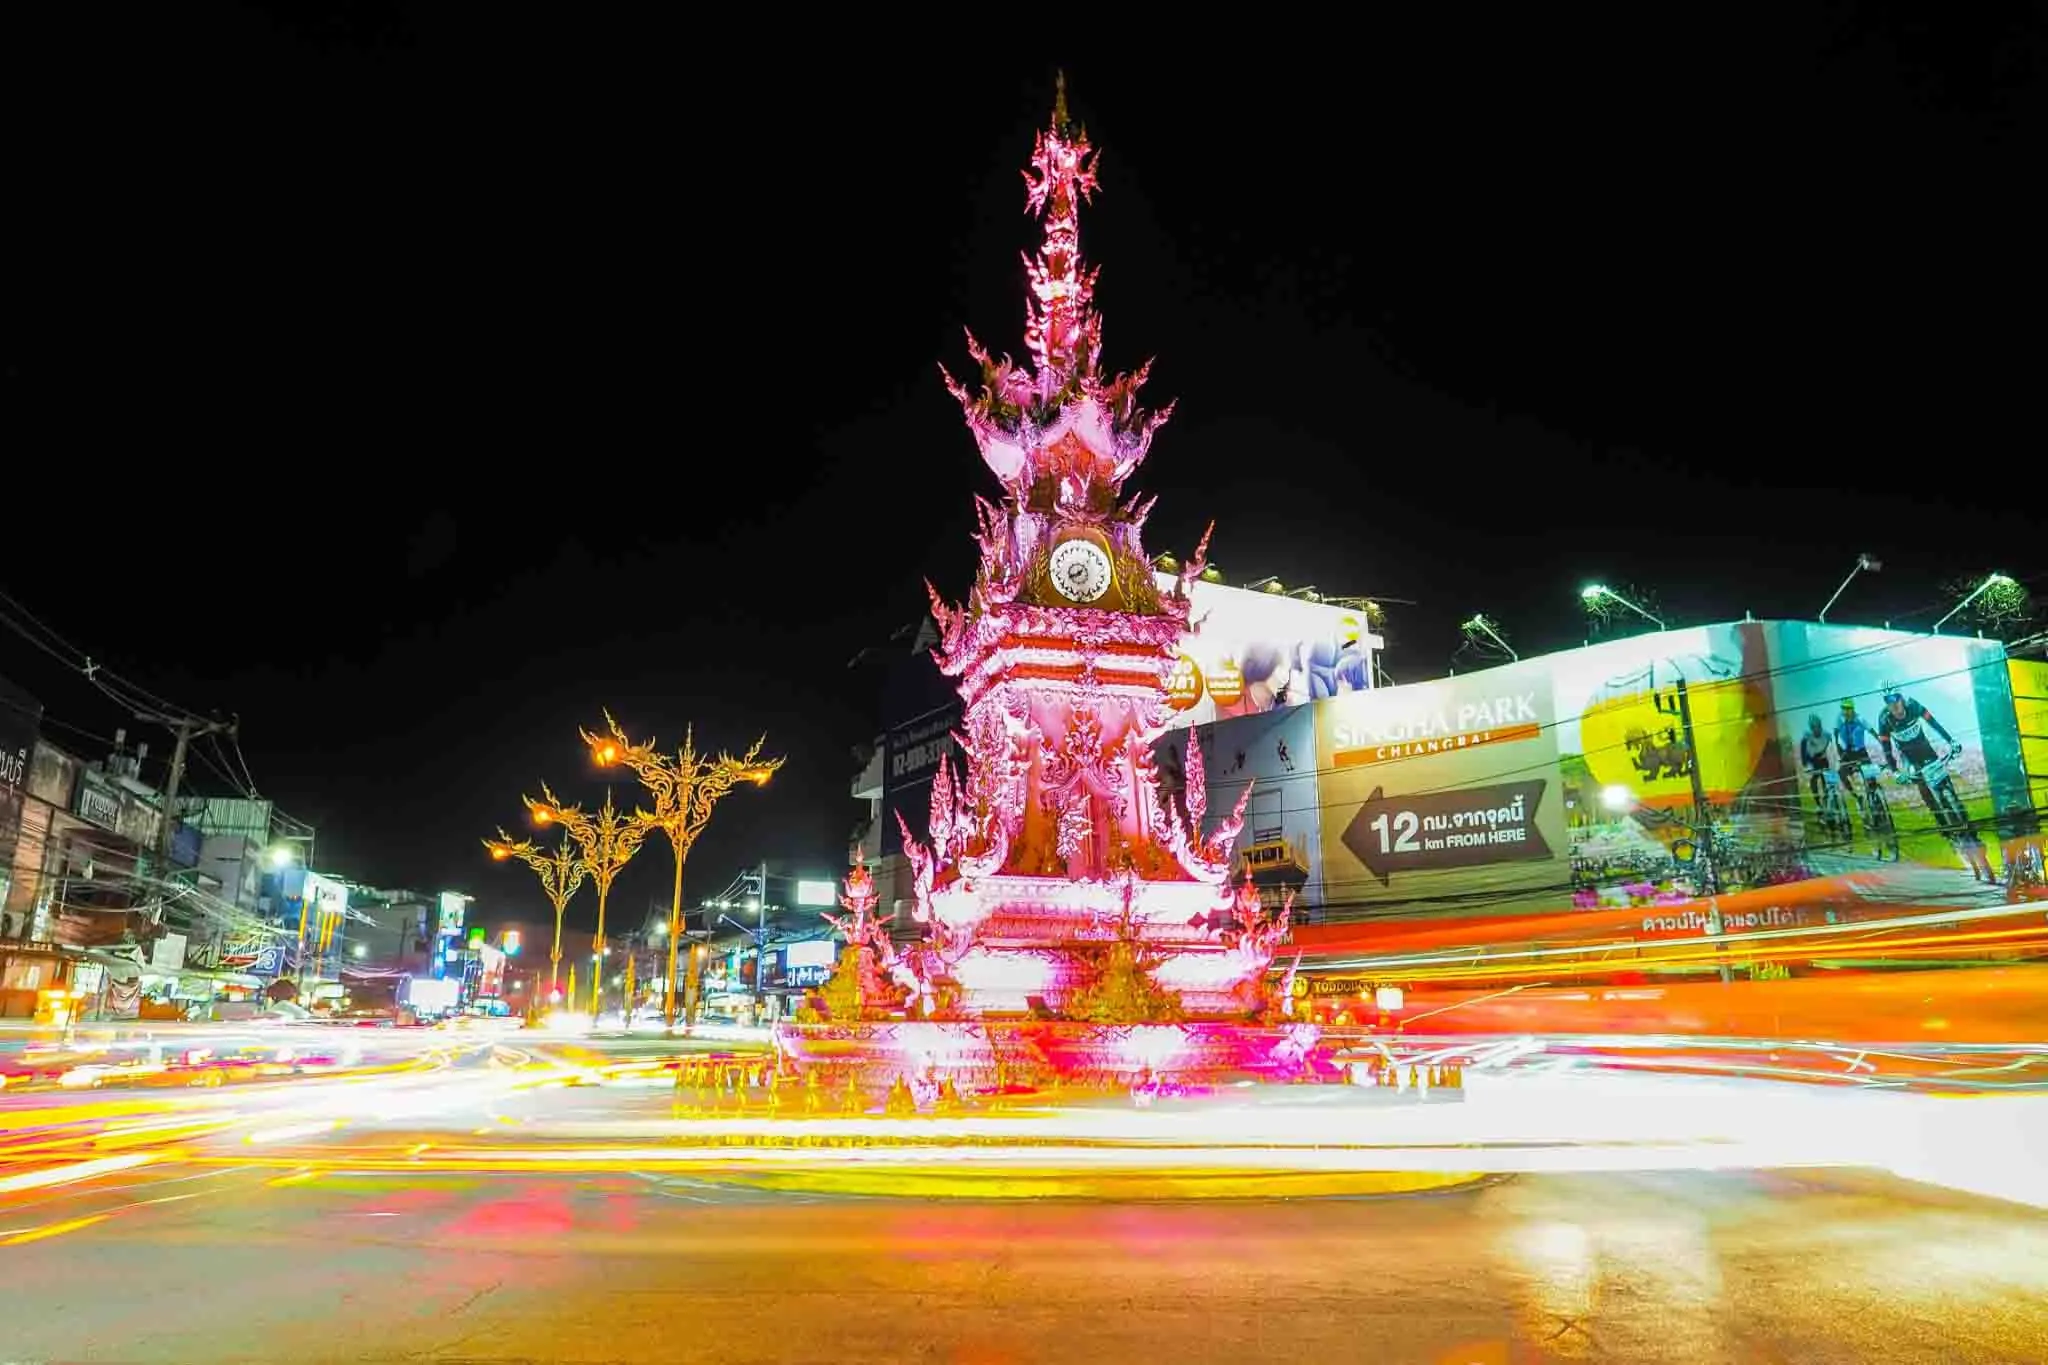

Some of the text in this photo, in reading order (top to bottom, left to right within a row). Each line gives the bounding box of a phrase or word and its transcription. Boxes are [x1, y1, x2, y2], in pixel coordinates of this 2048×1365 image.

[1458, 691, 1537, 730] PARK
[1376, 732, 1490, 759] CHIANGRAI
[1370, 795, 1524, 853] 12 กม.จากจุดนี้
[1425, 828, 1527, 851] km FROM HERE
